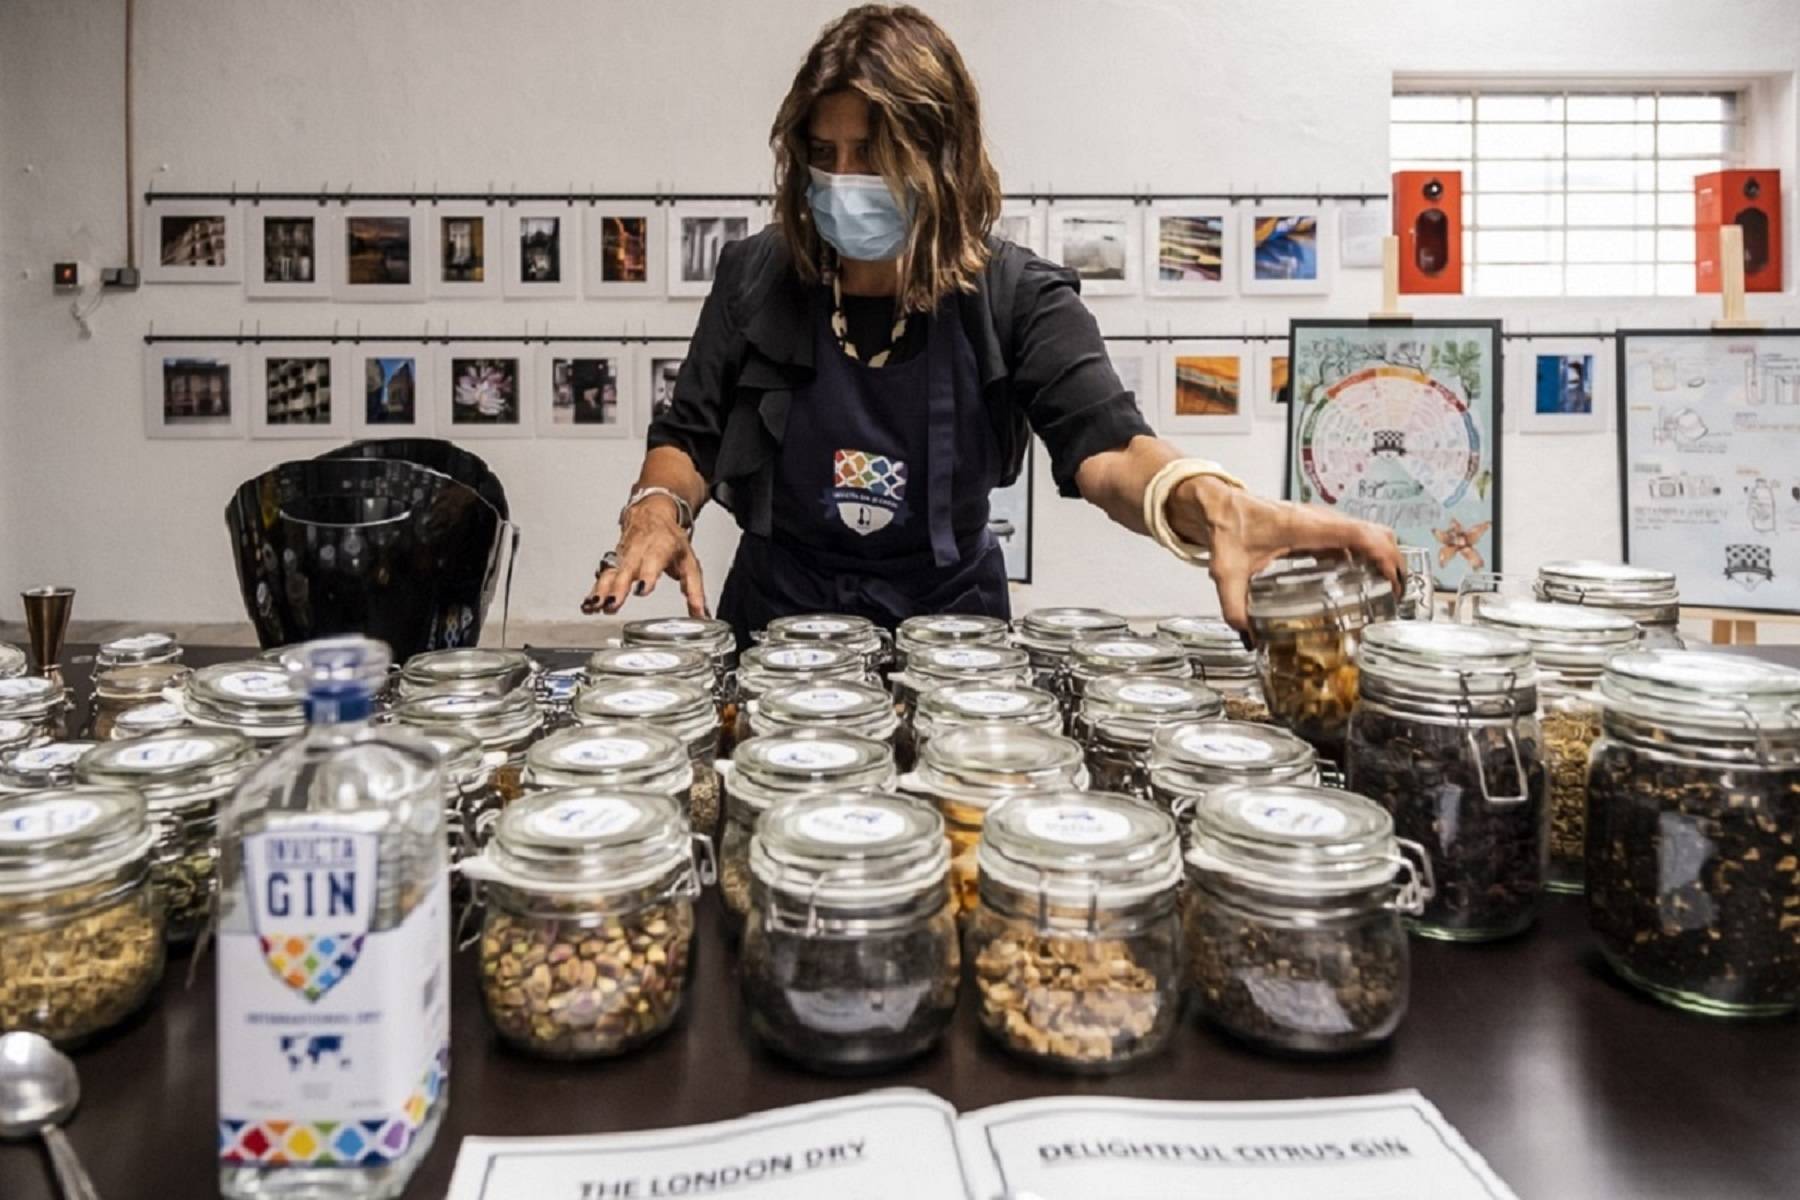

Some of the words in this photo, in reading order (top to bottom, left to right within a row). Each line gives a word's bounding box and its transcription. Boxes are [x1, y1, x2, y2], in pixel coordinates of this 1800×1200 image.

[267, 872, 355, 917] GIN
[580, 1180, 638, 1198] THE
[650, 1154, 794, 1197] LONDON
[804, 1137, 866, 1168] DRY
[1038, 1142, 1229, 1163] DELIGHTFUL
[1233, 1143, 1345, 1162] CITRUS
[1349, 1138, 1411, 1158] GIN
